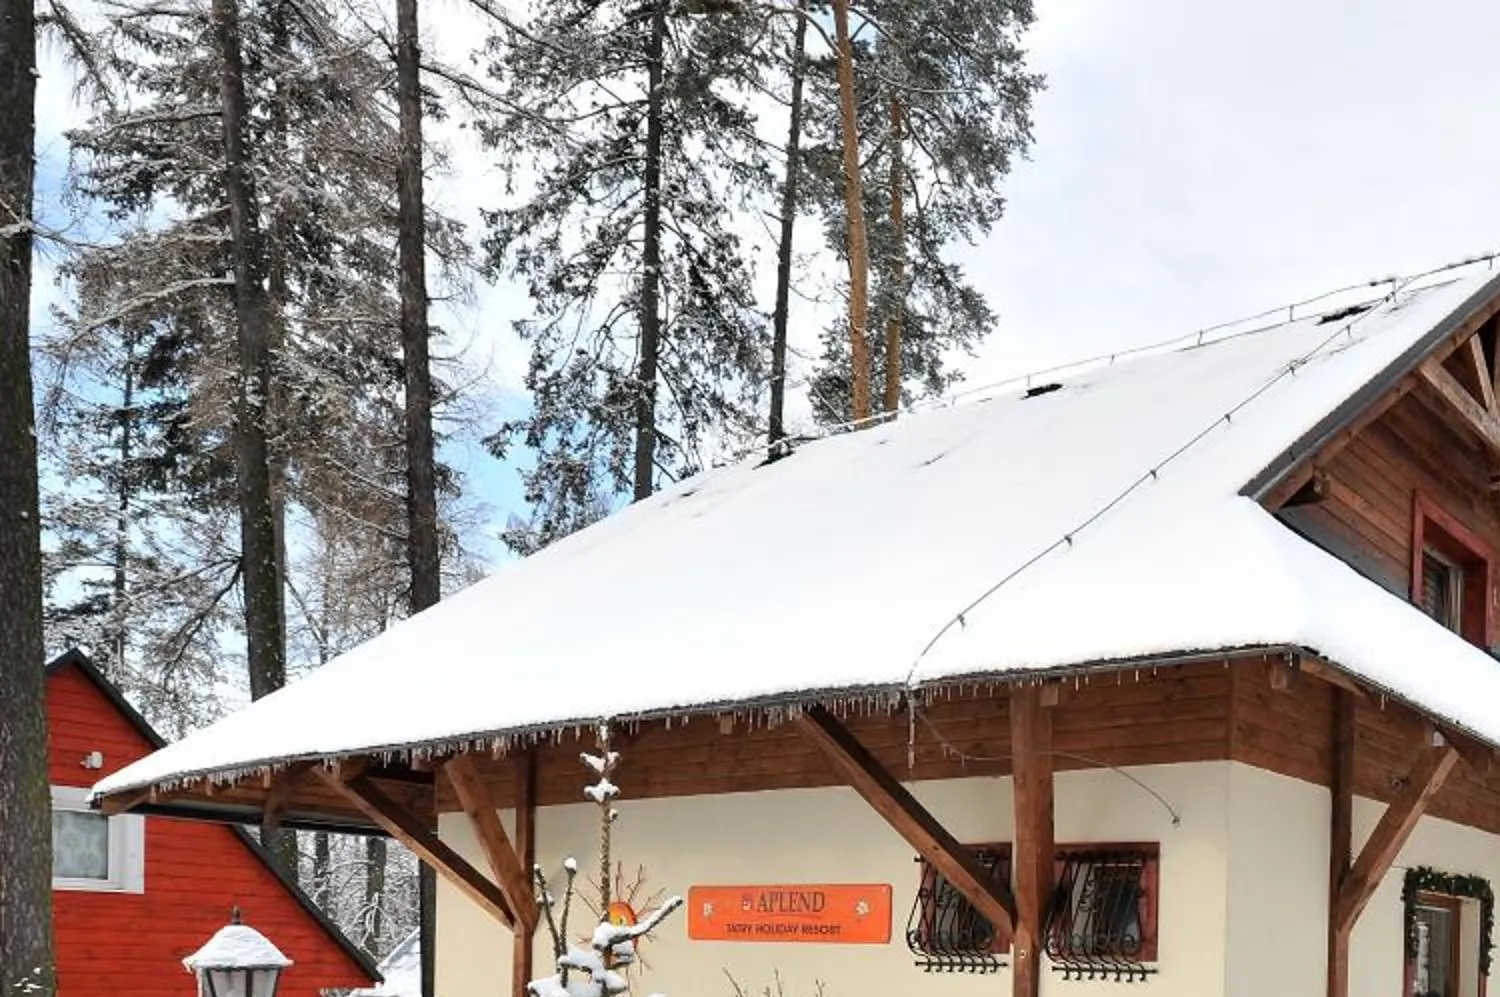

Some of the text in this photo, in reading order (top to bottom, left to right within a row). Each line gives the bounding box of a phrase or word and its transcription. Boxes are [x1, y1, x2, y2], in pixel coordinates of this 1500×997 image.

[757, 891, 825, 913] APLEND
[755, 923, 798, 935] HOLIDAY
[801, 924, 842, 936] RESORT
